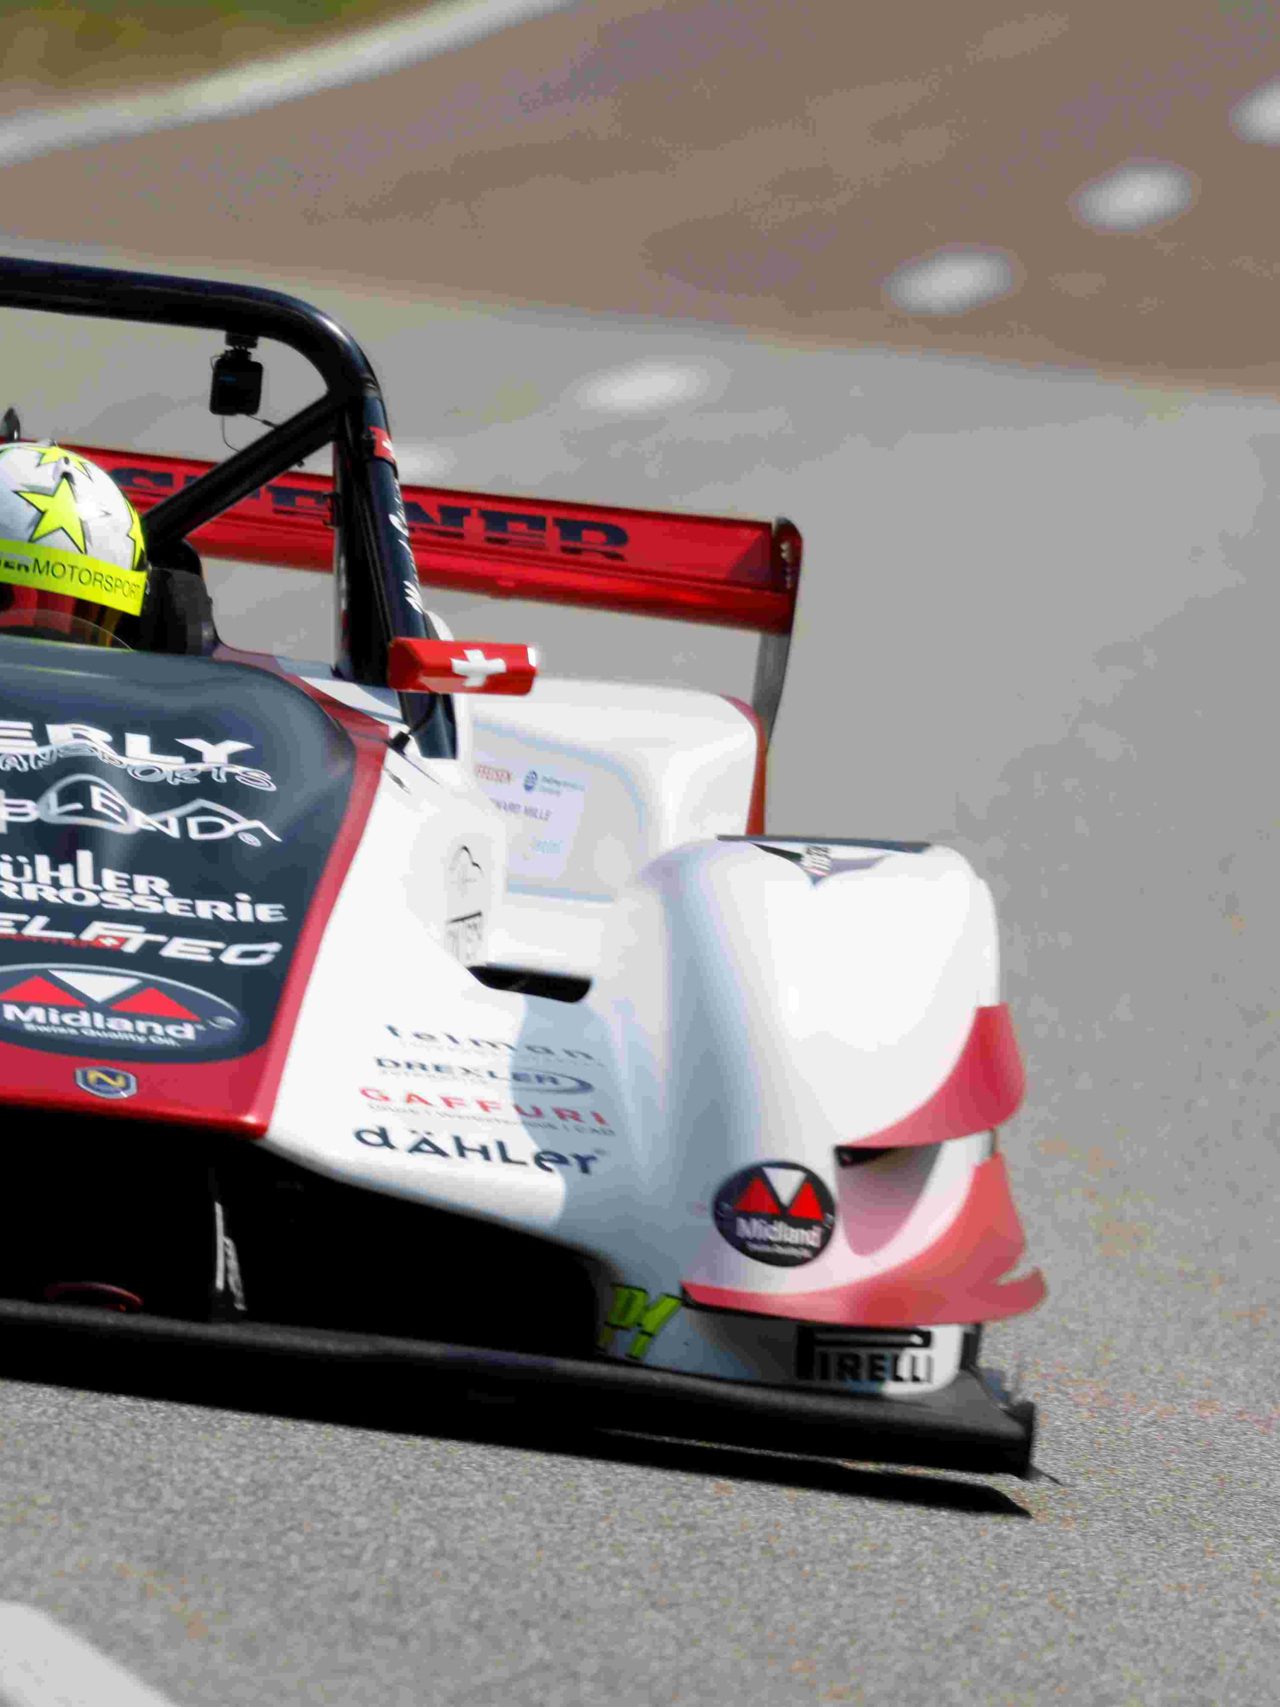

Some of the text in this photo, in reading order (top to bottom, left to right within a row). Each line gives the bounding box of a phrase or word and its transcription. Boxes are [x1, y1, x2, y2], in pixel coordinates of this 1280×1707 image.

[1, 1002, 197, 1042] Midland
[359, 1086, 610, 1127] GAFFURI
[795, 1325, 934, 1386] PIRELLI
